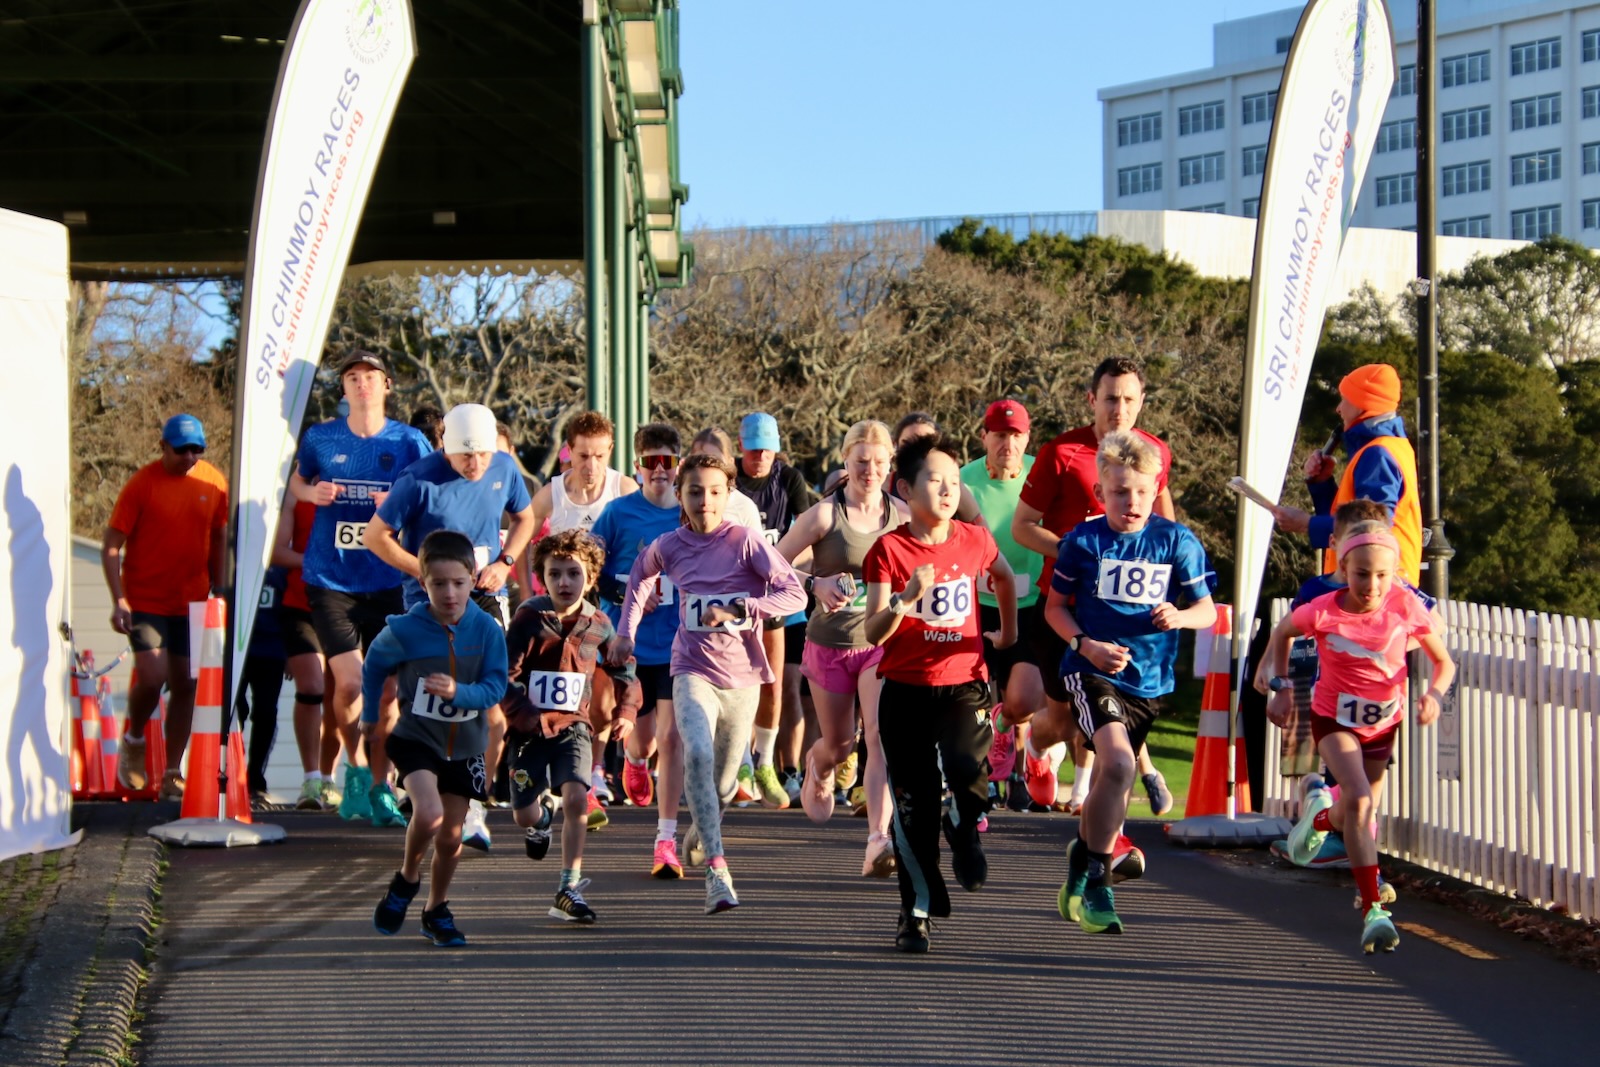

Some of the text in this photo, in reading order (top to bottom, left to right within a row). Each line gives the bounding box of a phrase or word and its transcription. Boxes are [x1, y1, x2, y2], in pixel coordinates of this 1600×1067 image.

[256, 67, 360, 390] SRI CHINMOY RACES
[276, 109, 364, 378] nz.srichinmoyraces.org
[1264, 89, 1346, 401] SRI CHINMOY RACES
[1107, 565, 1167, 599] 185
[924, 630, 963, 643] Waka
[423, 689, 470, 718] 18
[534, 674, 580, 706] 189
[1343, 700, 1397, 725] 18
